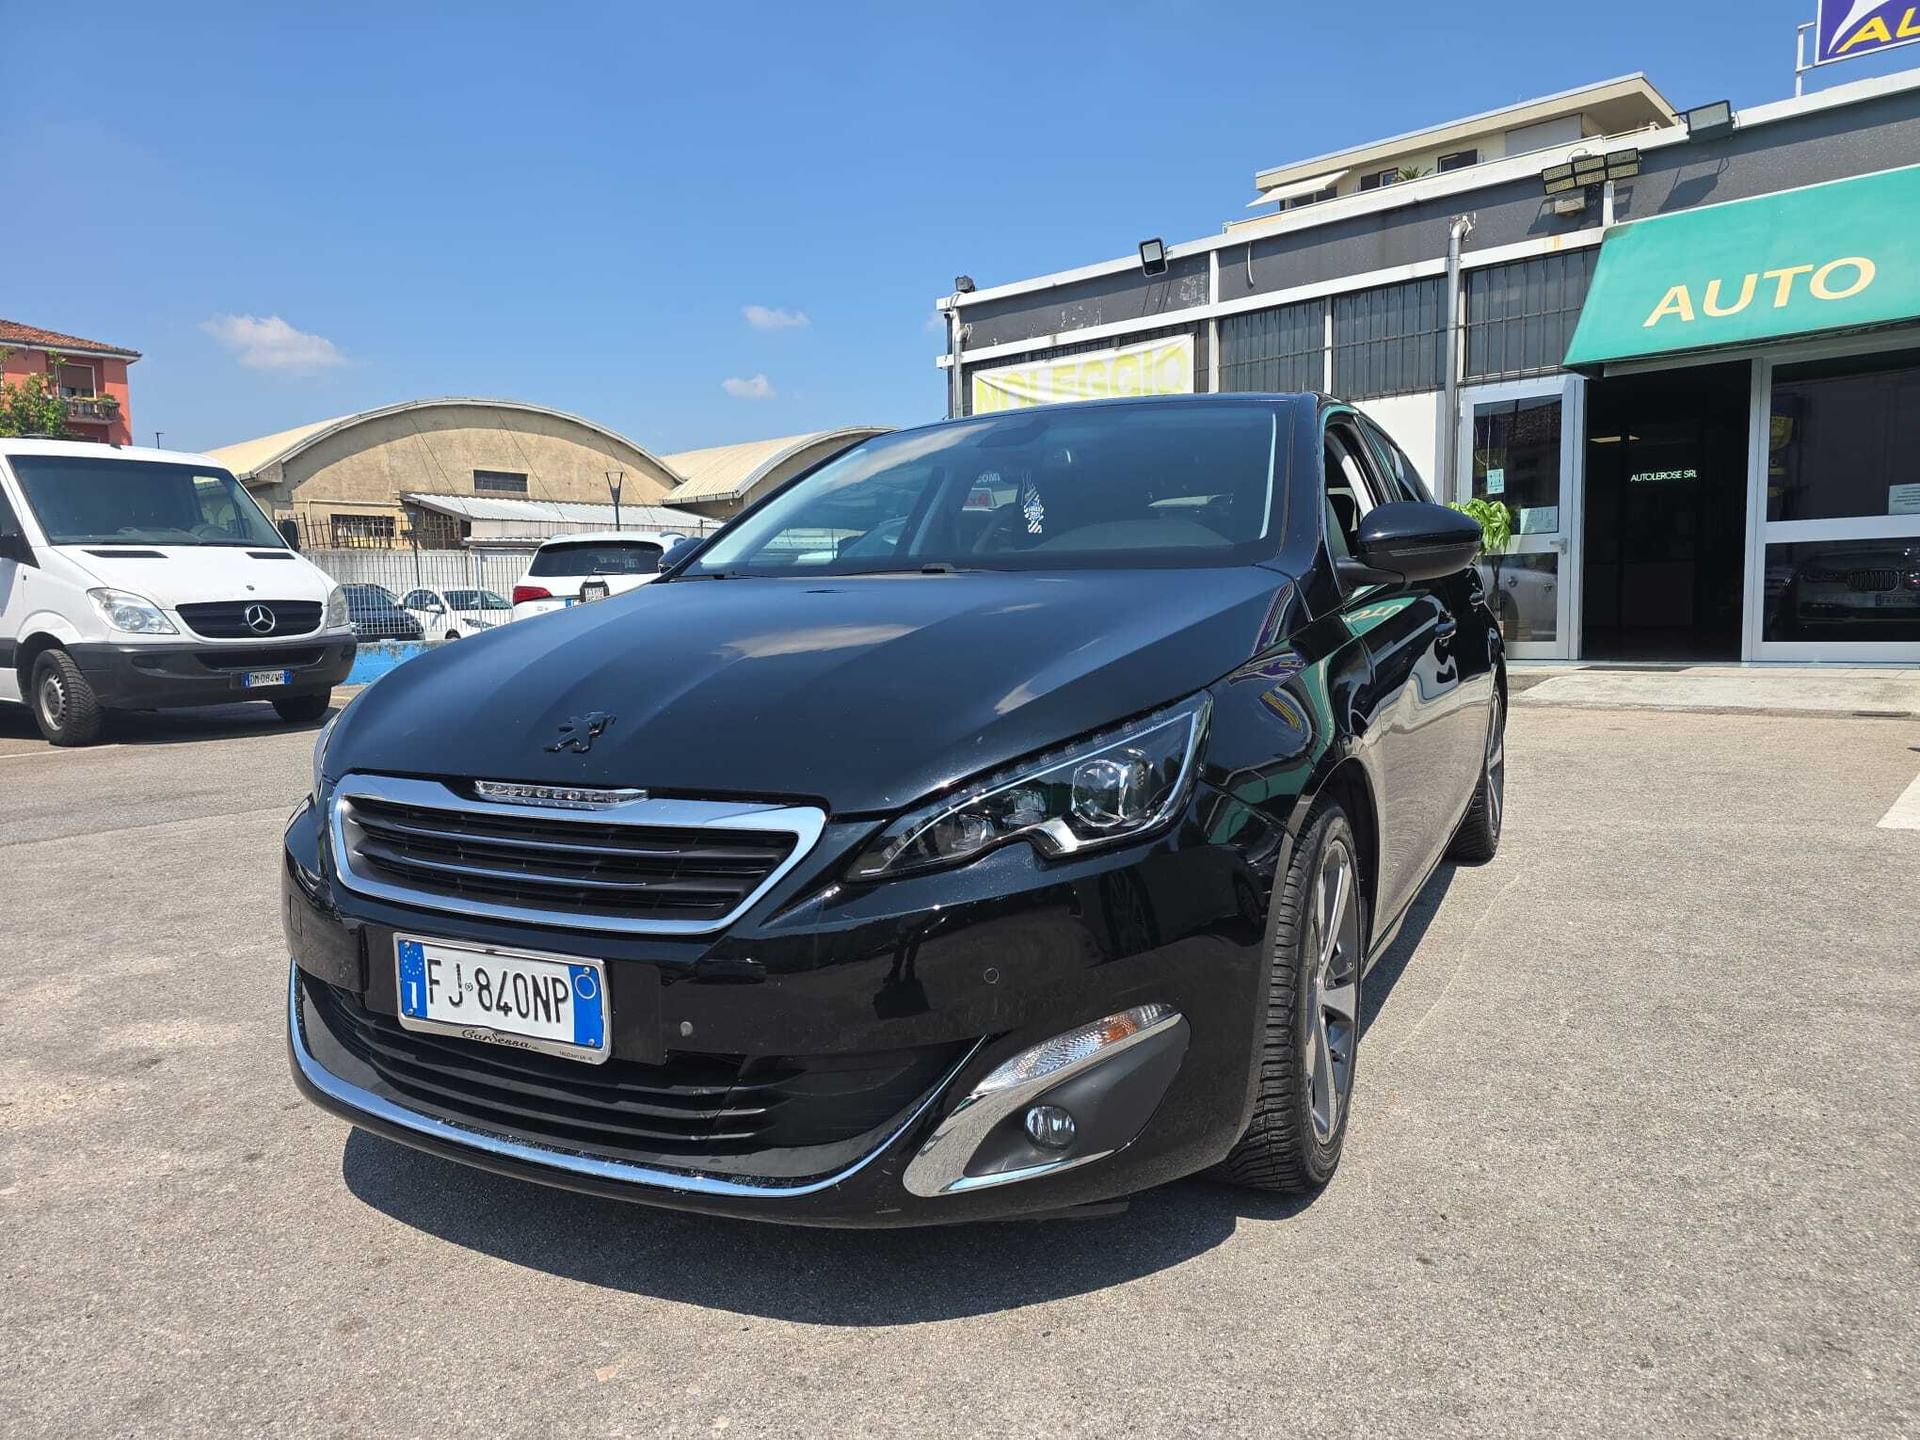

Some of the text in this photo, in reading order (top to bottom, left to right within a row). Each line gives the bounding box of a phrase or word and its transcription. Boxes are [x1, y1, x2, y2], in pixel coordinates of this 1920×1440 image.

[1643, 256, 1876, 328] AUTO
[1630, 469, 1698, 482] AUTOLEROSE SRL
